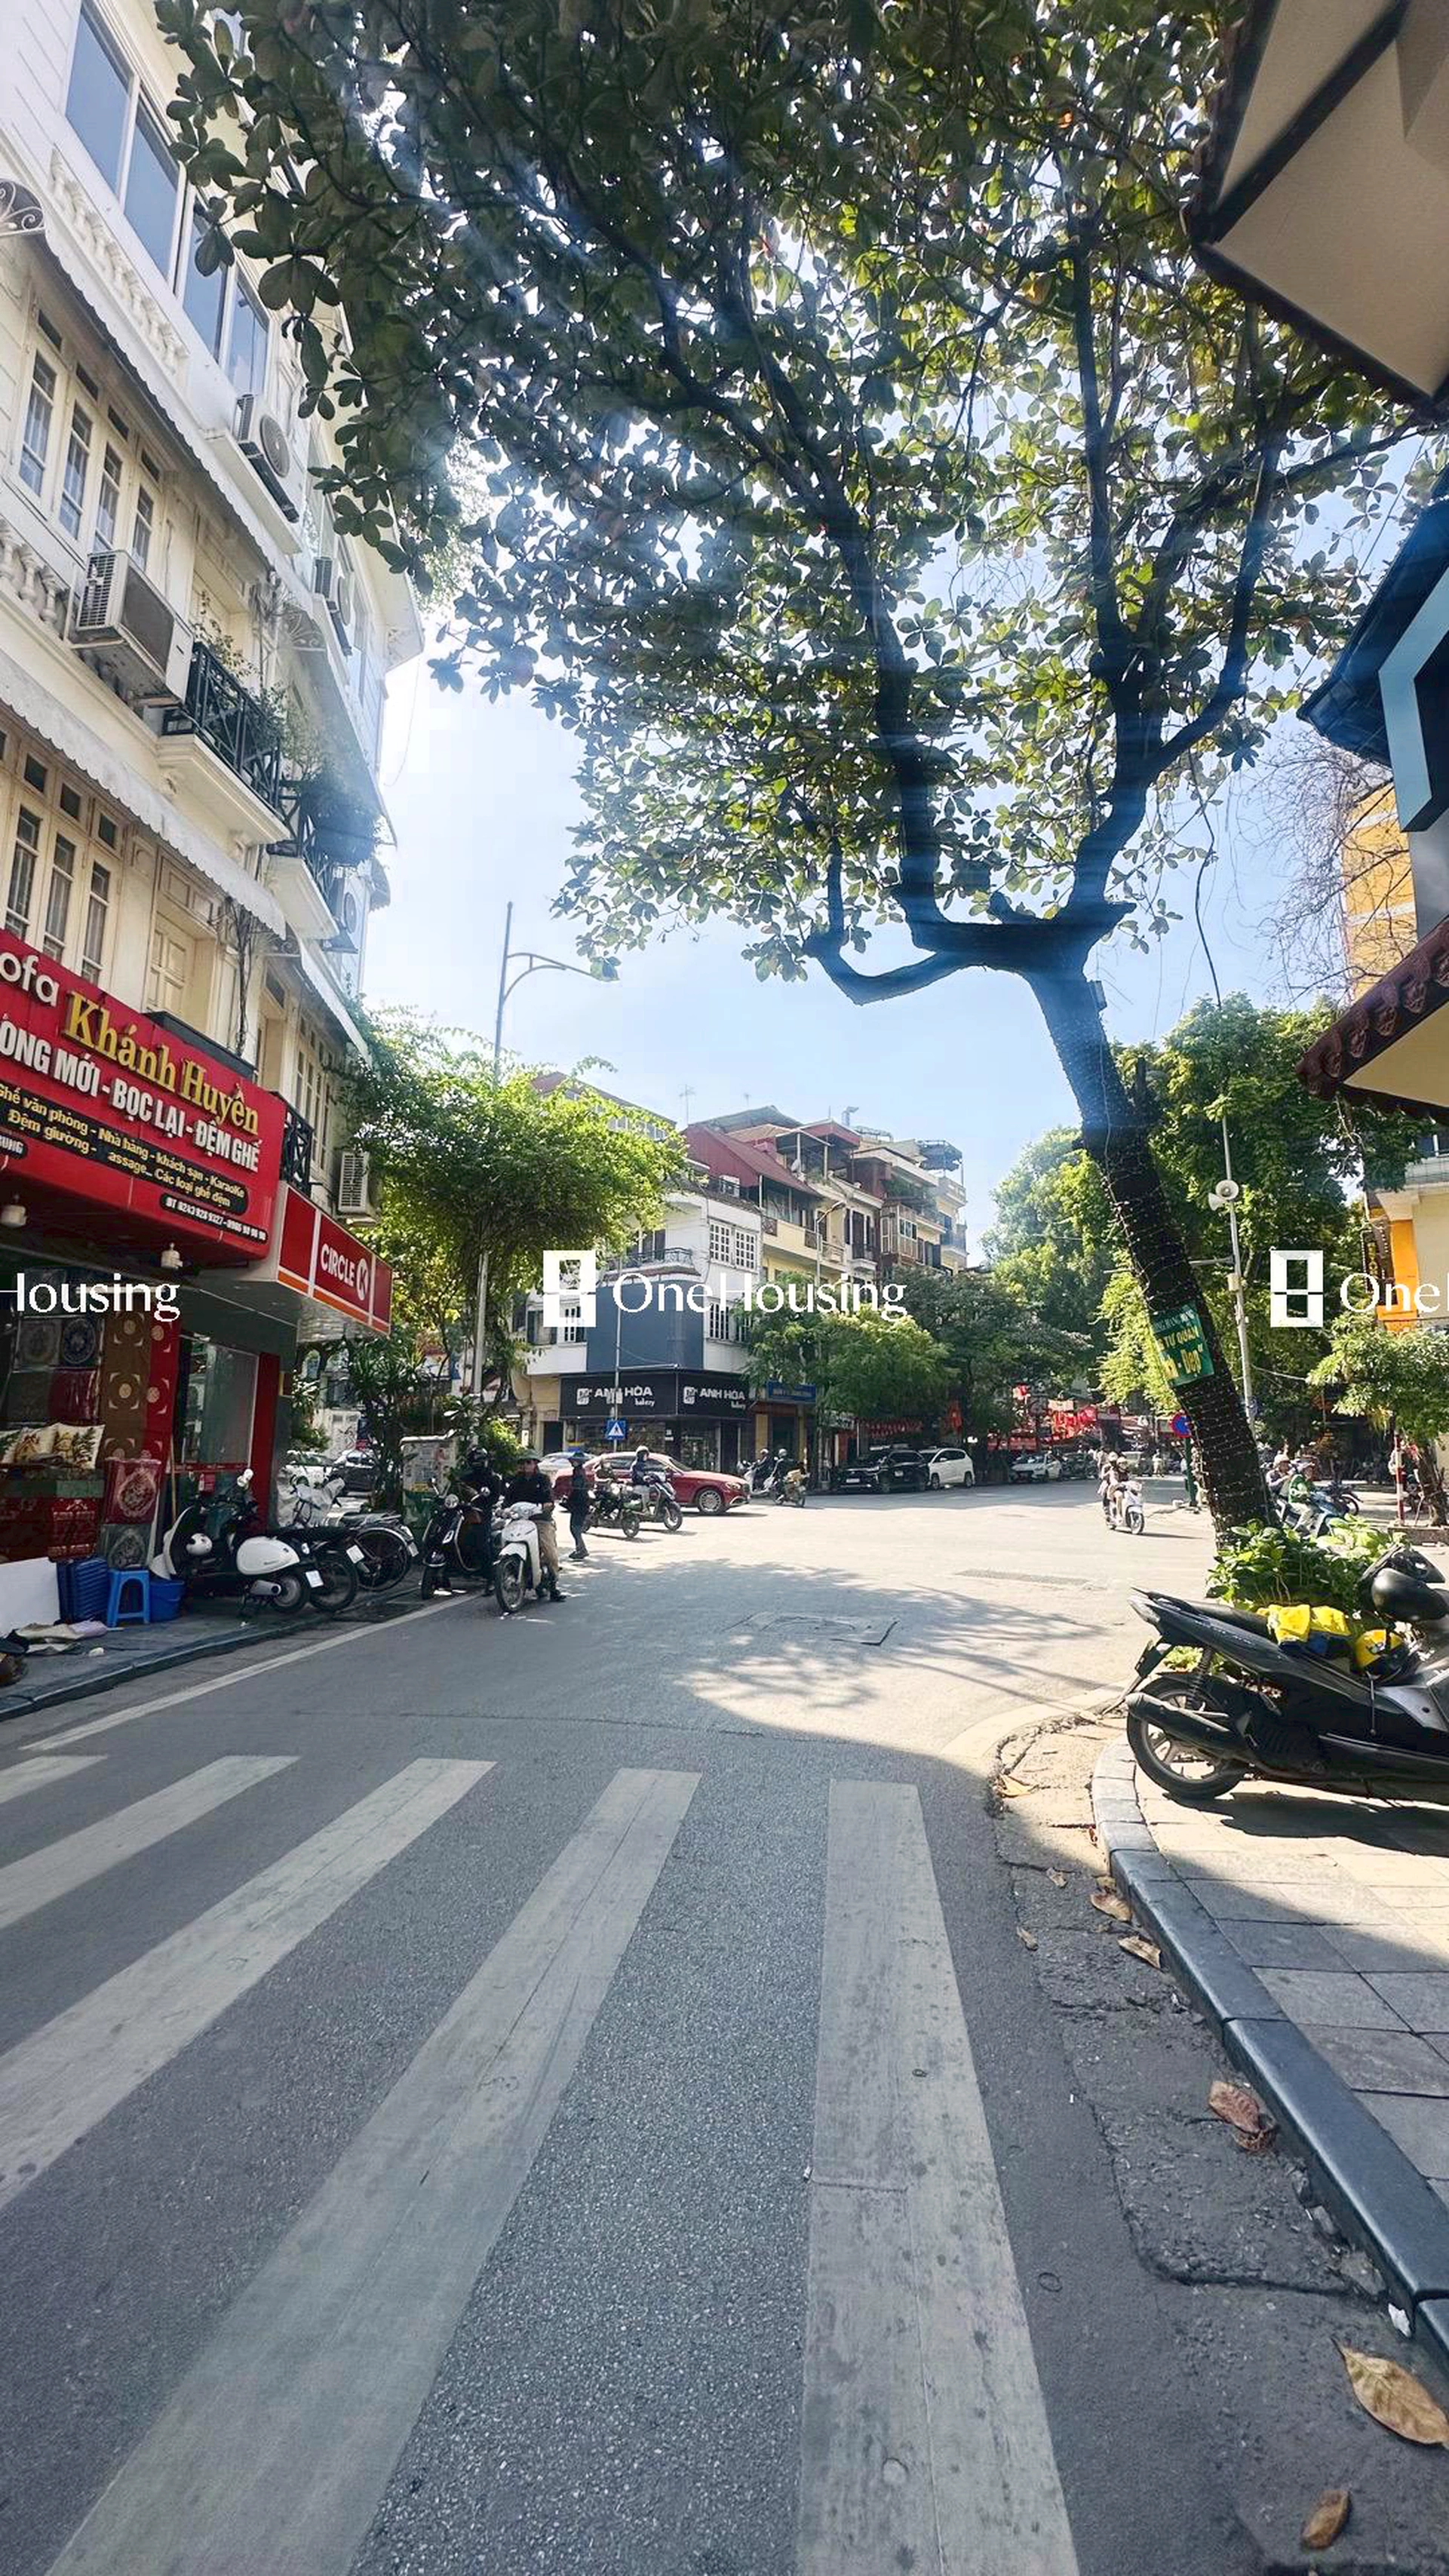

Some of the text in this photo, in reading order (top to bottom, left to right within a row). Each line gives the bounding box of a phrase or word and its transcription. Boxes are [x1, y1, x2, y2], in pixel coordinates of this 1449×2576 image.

[64, 990, 176, 1092] Khánh
[180, 1058, 259, 1135] Huyền
[23, 1098, 47, 1116] văn
[48, 1109, 88, 1135] phòng
[54, 1048, 100, 1097] MỚI
[112, 1078, 153, 1122] BỌC
[155, 1100, 186, 1138] LẠI
[194, 1119, 231, 1159] ĐỆM
[232, 1137, 262, 1173] GHẾ
[321, 1243, 355, 1287] CIRCLE
